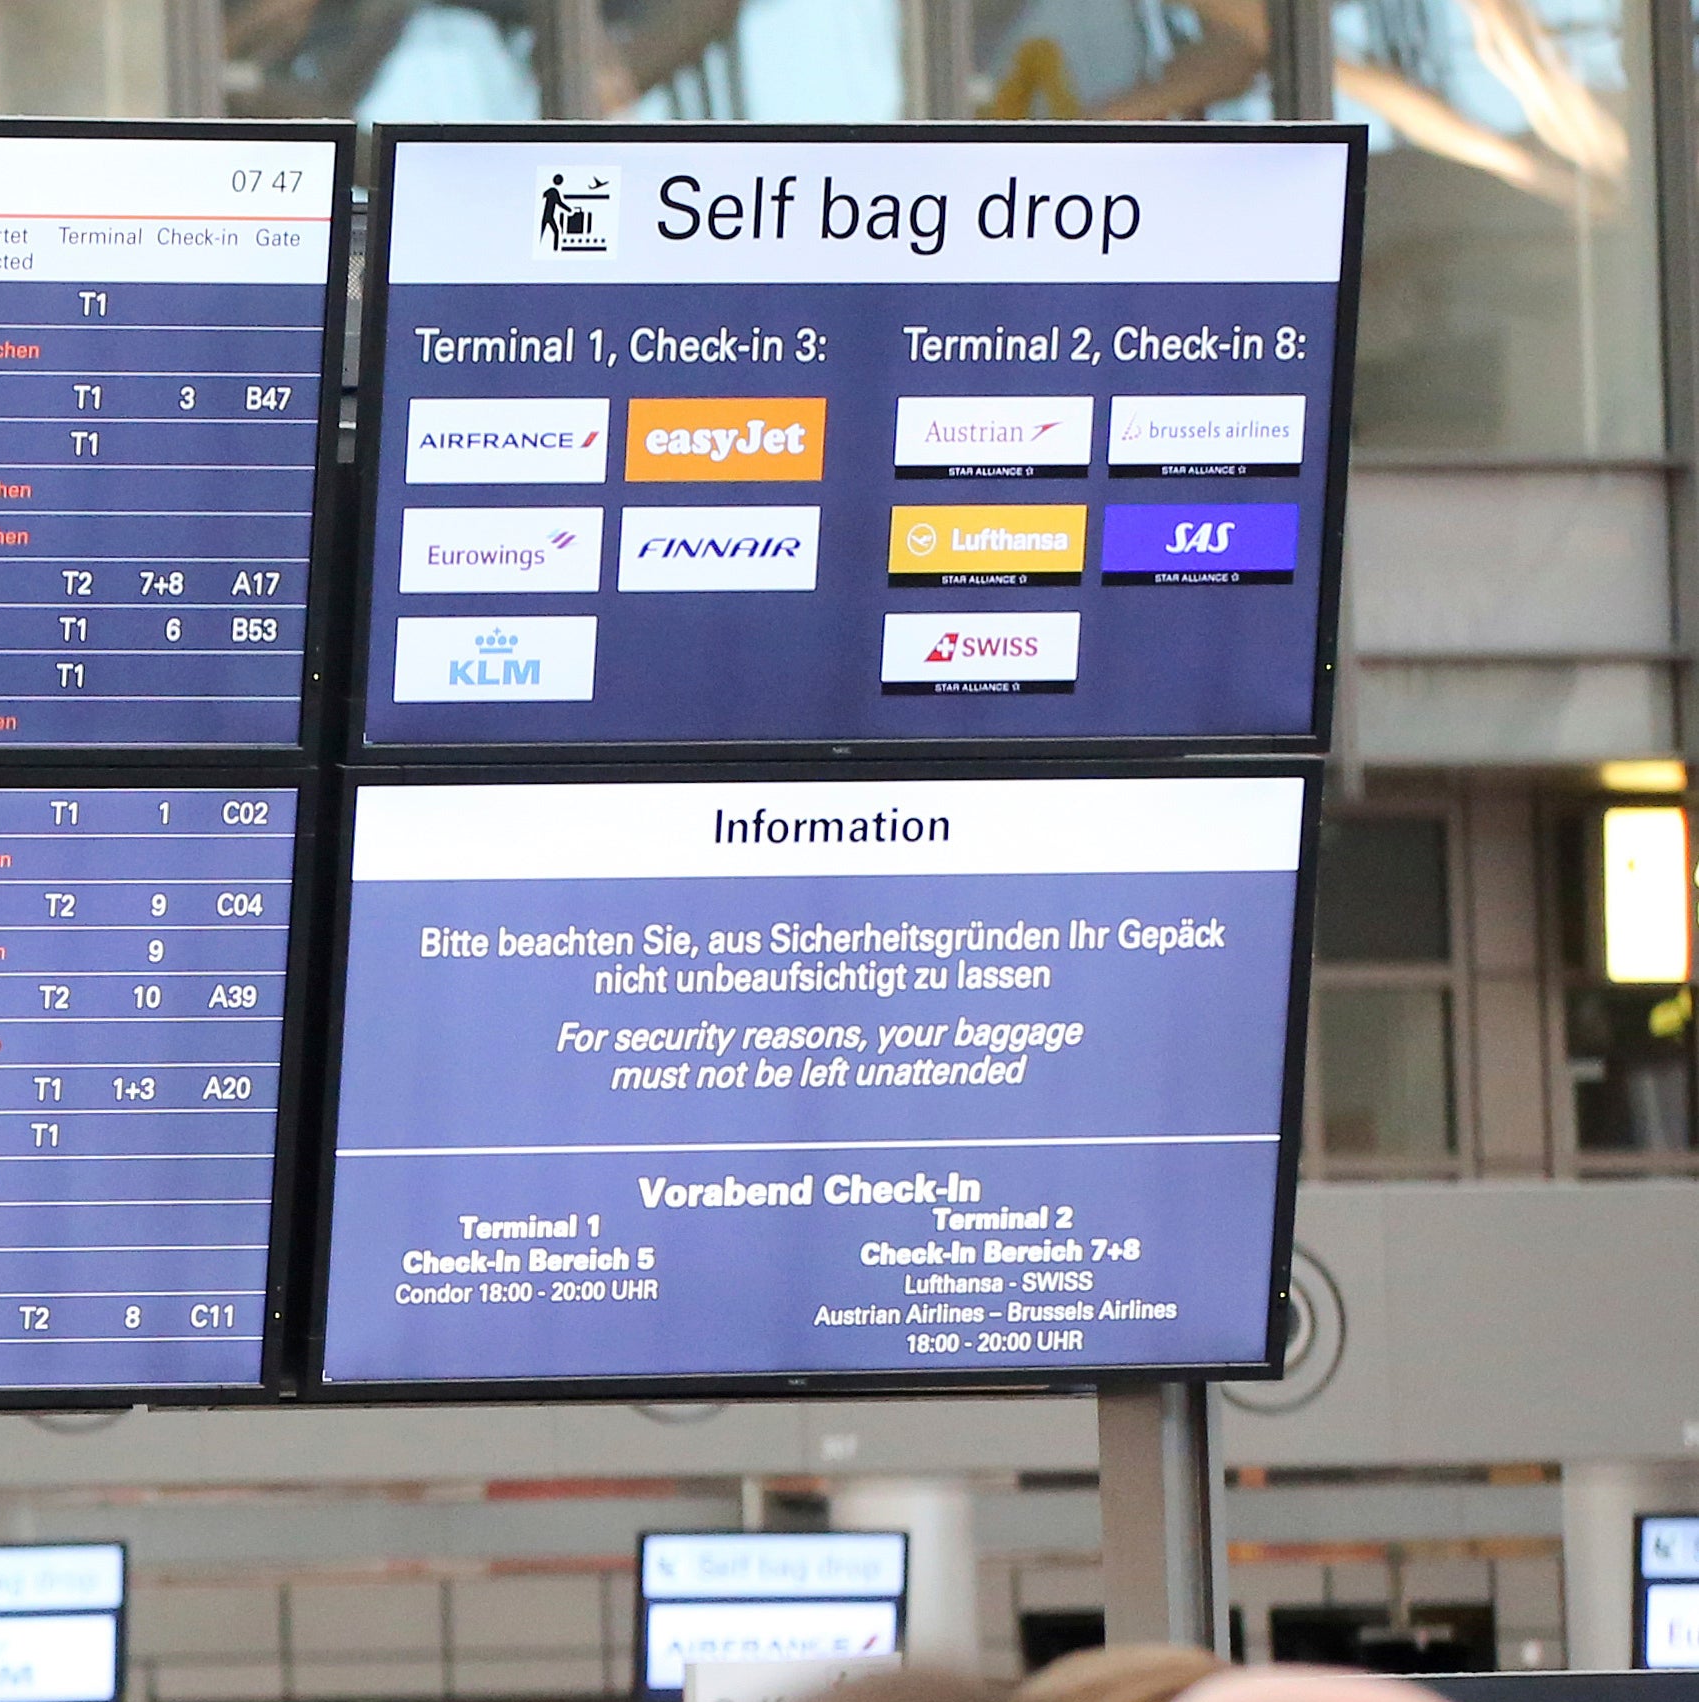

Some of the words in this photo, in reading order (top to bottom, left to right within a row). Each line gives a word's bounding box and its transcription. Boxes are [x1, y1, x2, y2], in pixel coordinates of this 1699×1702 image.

[657, 174, 797, 241] Self
[821, 176, 948, 256] bag
[977, 176, 1141, 255] drop
[414, 327, 574, 363] Terminal
[589, 328, 617, 368] 1,
[630, 326, 783, 363] Check-in
[795, 327, 827, 362] 3:
[903, 326, 1059, 362] Terminal
[1070, 326, 1101, 366] 2,
[1113, 325, 1264, 361] Check-in
[1274, 326, 1306, 360] 8:
[73, 384, 101, 410] T1
[179, 386, 195, 410] 3
[246, 386, 292, 411] B47
[646, 419, 806, 462] easyJet
[924, 420, 1024, 443] Austrian
[1149, 420, 1221, 439] brussels
[1225, 420, 1290, 439] airlines
[948, 467, 973, 476] STAR
[976, 467, 1023, 476] ALLIANCE
[1161, 466, 1186, 475] STAR
[1189, 466, 1235, 474] ALLIANCE
[638, 537, 801, 558] FINNAIR
[952, 527, 1068, 551] Lufthansa
[1165, 521, 1236, 553] SAS
[427, 544, 545, 571] Eurowings
[942, 576, 966, 584] STAR
[969, 575, 1016, 583] ALLIANCE
[1154, 574, 1179, 583] STAR
[1182, 574, 1228, 582] ALLIANCE
[962, 636, 1038, 658] SWISS
[448, 659, 541, 686] KLM
[935, 683, 960, 692] STAR
[962, 683, 1009, 691] ALLIANCE
[715, 807, 950, 844] Information
[420, 927, 489, 958] Bitte
[498, 925, 634, 957] beachten
[643, 924, 699, 959] Sie,
[708, 930, 762, 955] aus
[770, 920, 1060, 959] Sicherheitsgründen
[1069, 919, 1111, 950] Ihr
[1117, 917, 1226, 955] Gepäck
[595, 963, 668, 994] nicht
[676, 960, 908, 998] unbeaufsichtigt
[913, 967, 948, 990] zu
[957, 959, 1051, 990] lassen
[556, 1021, 610, 1053] For
[614, 1020, 737, 1057] security
[742, 1025, 868, 1053] reasons,
[877, 1024, 949, 1055] your
[953, 1016, 1084, 1053] baggage
[611, 1062, 691, 1090] must
[696, 1061, 749, 1089] not
[754, 1057, 793, 1088] be
[800, 1056, 851, 1088] left
[856, 1053, 1028, 1086] unattended
[638, 1174, 814, 1208] Vorabend
[823, 1172, 981, 1205] Check-In
[459, 1213, 578, 1240] Terminal
[587, 1214, 600, 1238] 1
[932, 1205, 1049, 1231] Terminal
[1055, 1205, 1074, 1229] 2
[403, 1250, 521, 1273] Check-In
[529, 1247, 630, 1272] Bereich
[637, 1247, 655, 1270] 5
[860, 1240, 977, 1266] Check-In
[983, 1238, 1083, 1264] Bereich
[1090, 1238, 1141, 1261] 7+8
[395, 1282, 474, 1305] Condor
[479, 1282, 533, 1303] 18:00
[550, 1280, 606, 1302] 20:00
[611, 1278, 659, 1301] UHR
[904, 1273, 1004, 1295] Lufthansa
[1021, 1270, 1094, 1292] SWISS
[19, 1306, 50, 1330] T2
[125, 1305, 141, 1329] 8
[190, 1304, 234, 1328] C11
[813, 1304, 901, 1326] Austrian
[905, 1303, 985, 1324] Airlines
[1007, 1300, 1095, 1322] Brussels
[1097, 1299, 1178, 1320] Airlines
[906, 1333, 960, 1354] 18:00
[976, 1331, 1032, 1352] 20:00
[1037, 1329, 1084, 1351] UHR
